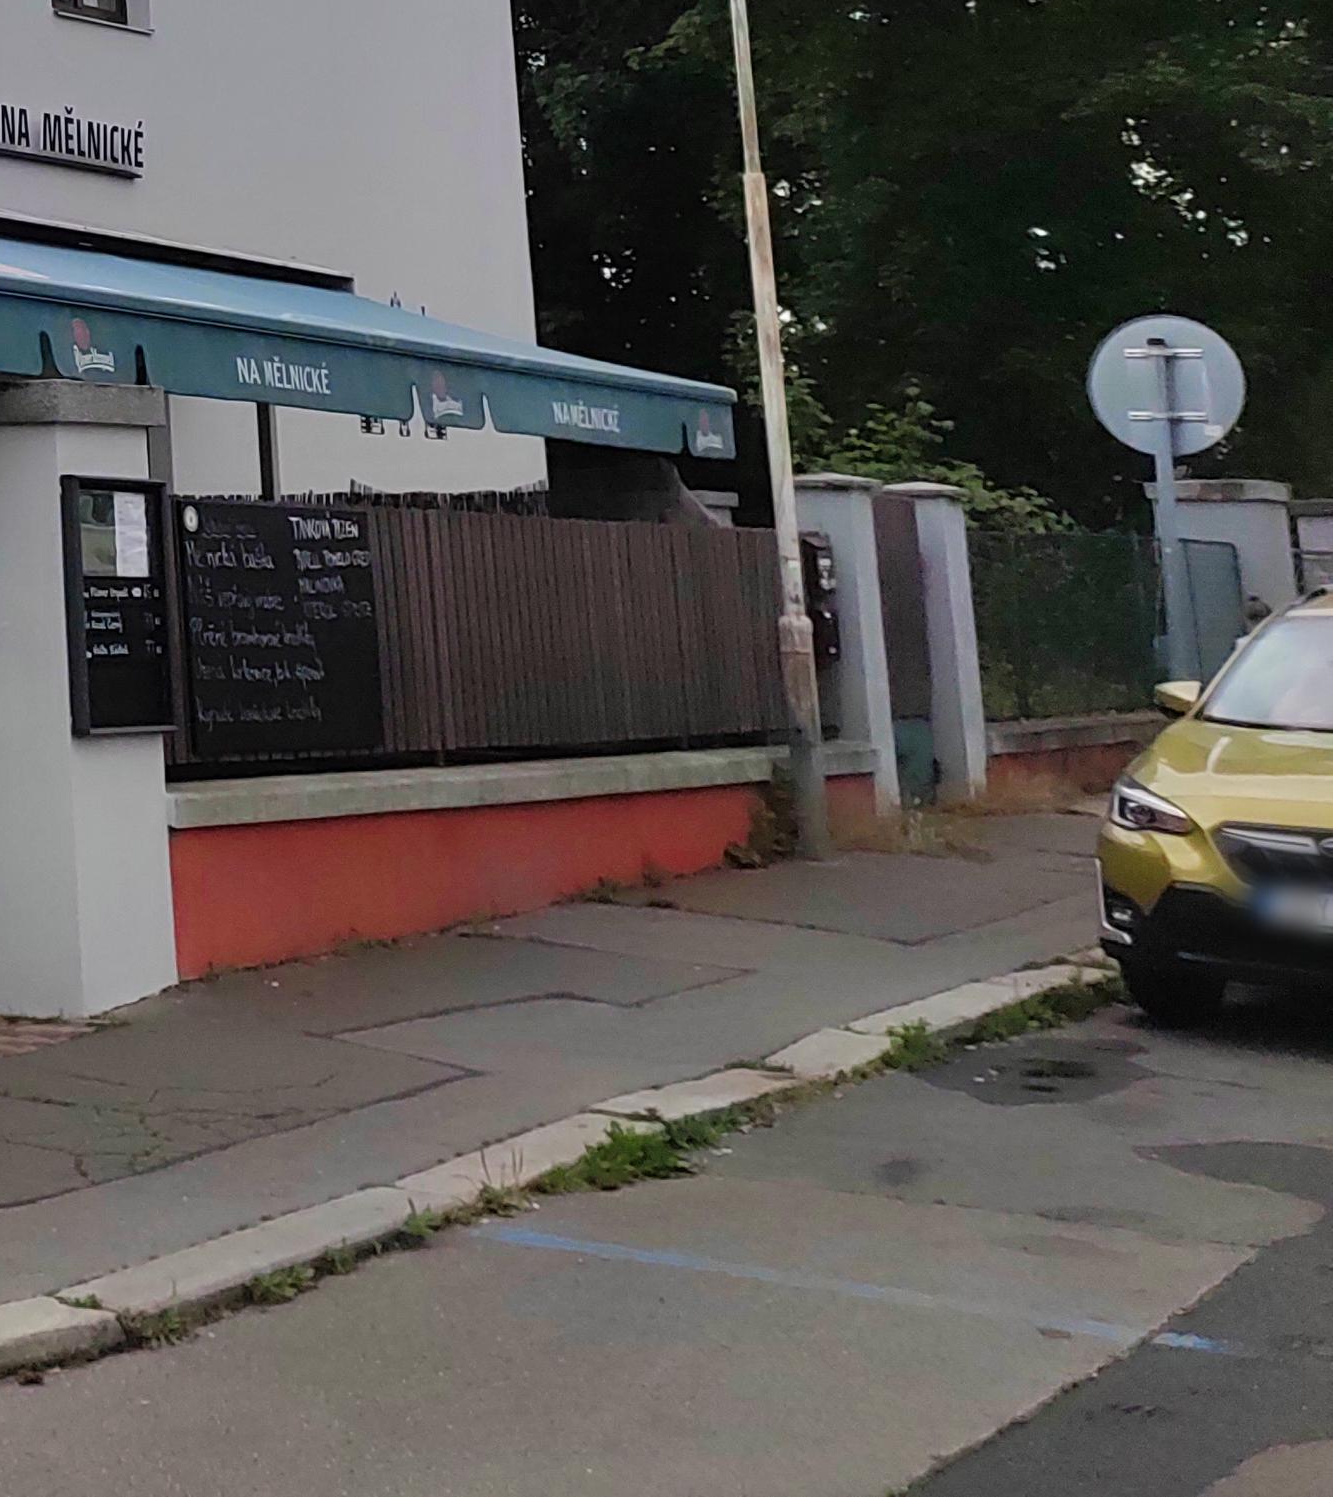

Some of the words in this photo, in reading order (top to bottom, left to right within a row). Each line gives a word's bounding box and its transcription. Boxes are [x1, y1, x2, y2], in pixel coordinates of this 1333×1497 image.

[0, 104, 30, 147] NA
[42, 106, 144, 168] MĚLNICKÉ
[236, 357, 261, 385] NA
[263, 355, 331, 394] MĚLNICKÉ
[552, 402, 571, 425] NA
